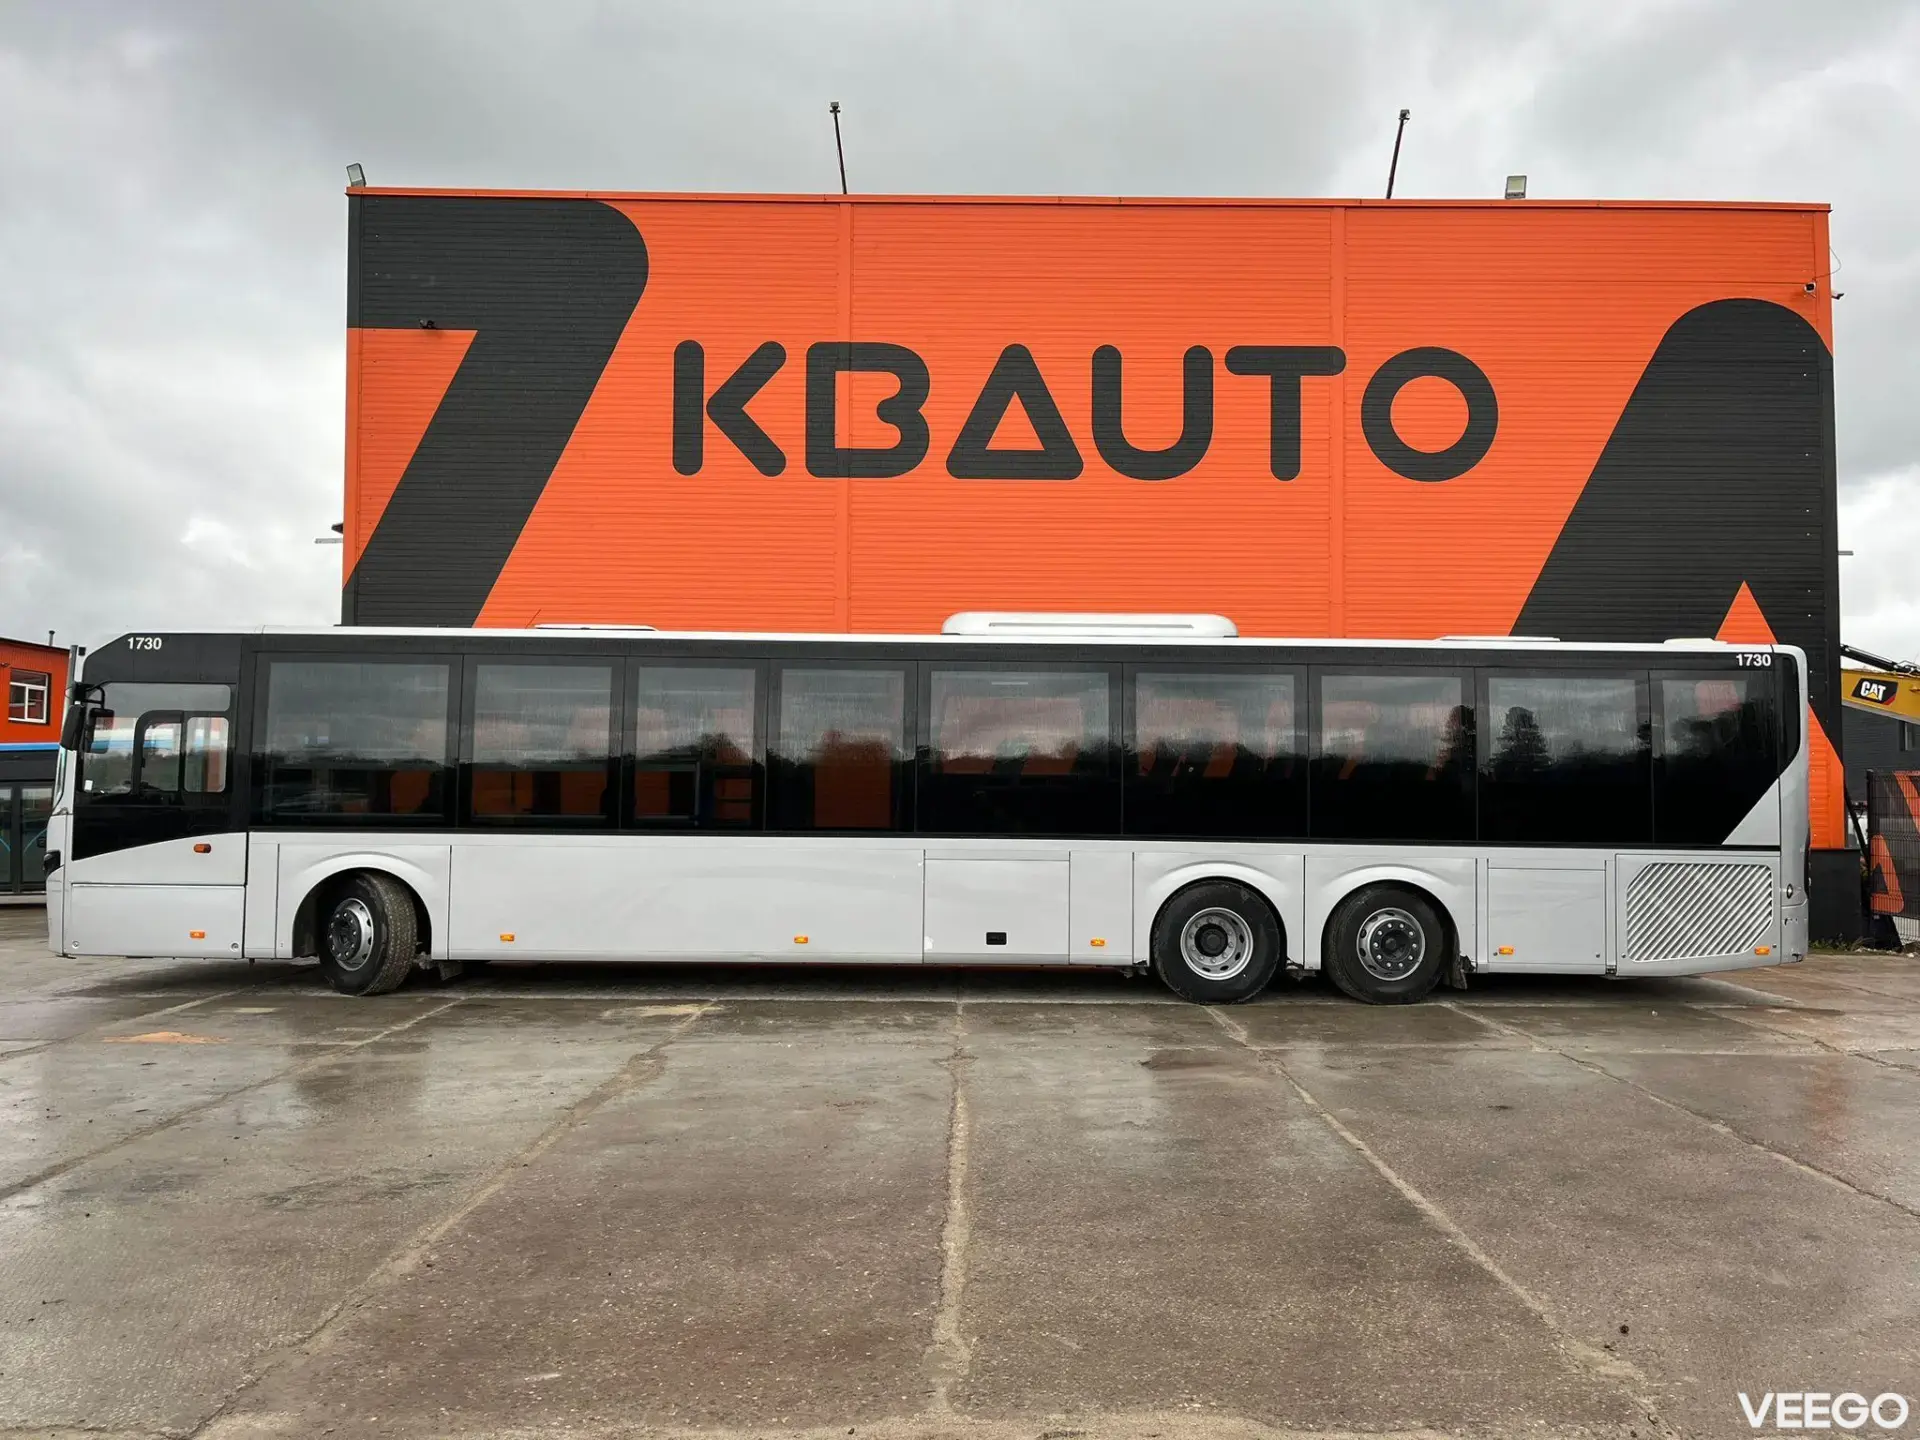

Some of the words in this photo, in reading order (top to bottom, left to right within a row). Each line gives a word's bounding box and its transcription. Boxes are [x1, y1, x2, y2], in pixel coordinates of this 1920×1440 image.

[673, 339, 1499, 482] KBAUTO
[127, 637, 162, 650] 1730
[1736, 653, 1771, 667] 1730
[1860, 681, 1886, 701] CAT
